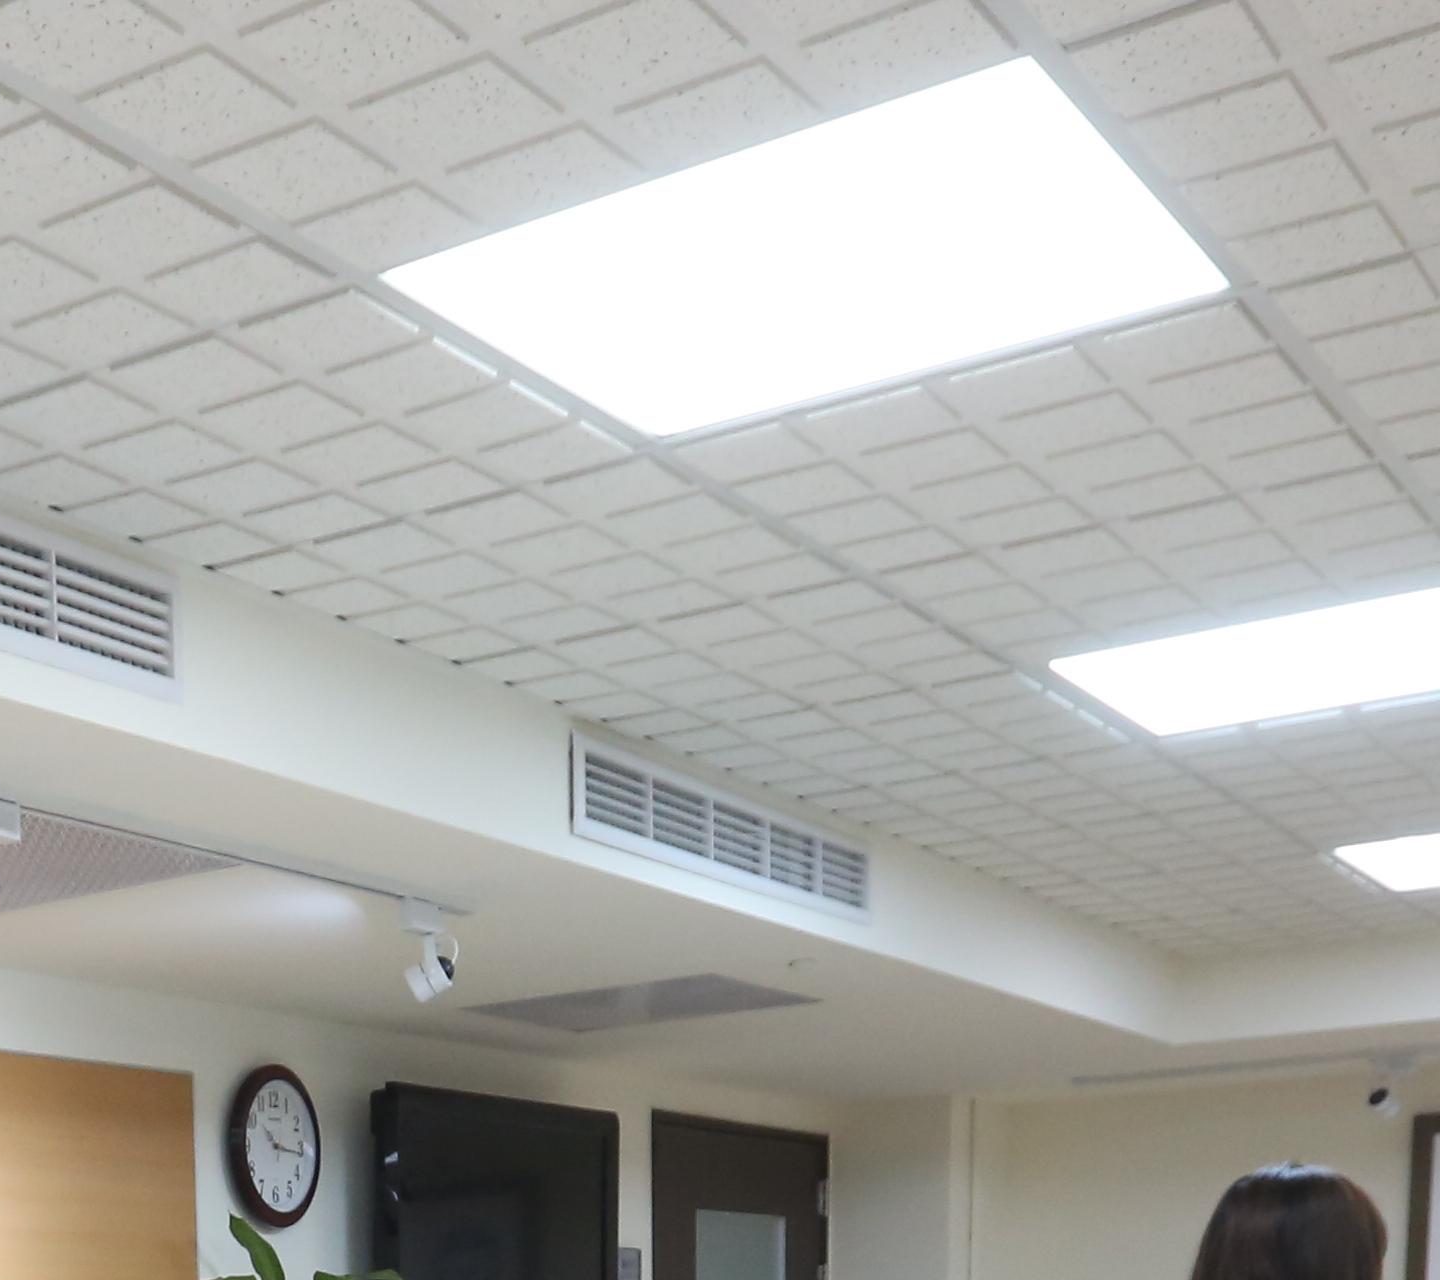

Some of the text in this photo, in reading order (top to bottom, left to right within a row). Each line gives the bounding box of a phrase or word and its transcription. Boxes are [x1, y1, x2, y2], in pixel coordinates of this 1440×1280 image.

[268, 1091, 279, 1108] 12
[293, 1115, 300, 1132] 2
[297, 1141, 305, 1158] 3
[294, 1163, 300, 1181] 4
[258, 1179, 265, 1198] 7
[272, 1186, 280, 1203] 6
[286, 1181, 293, 1198] 5
